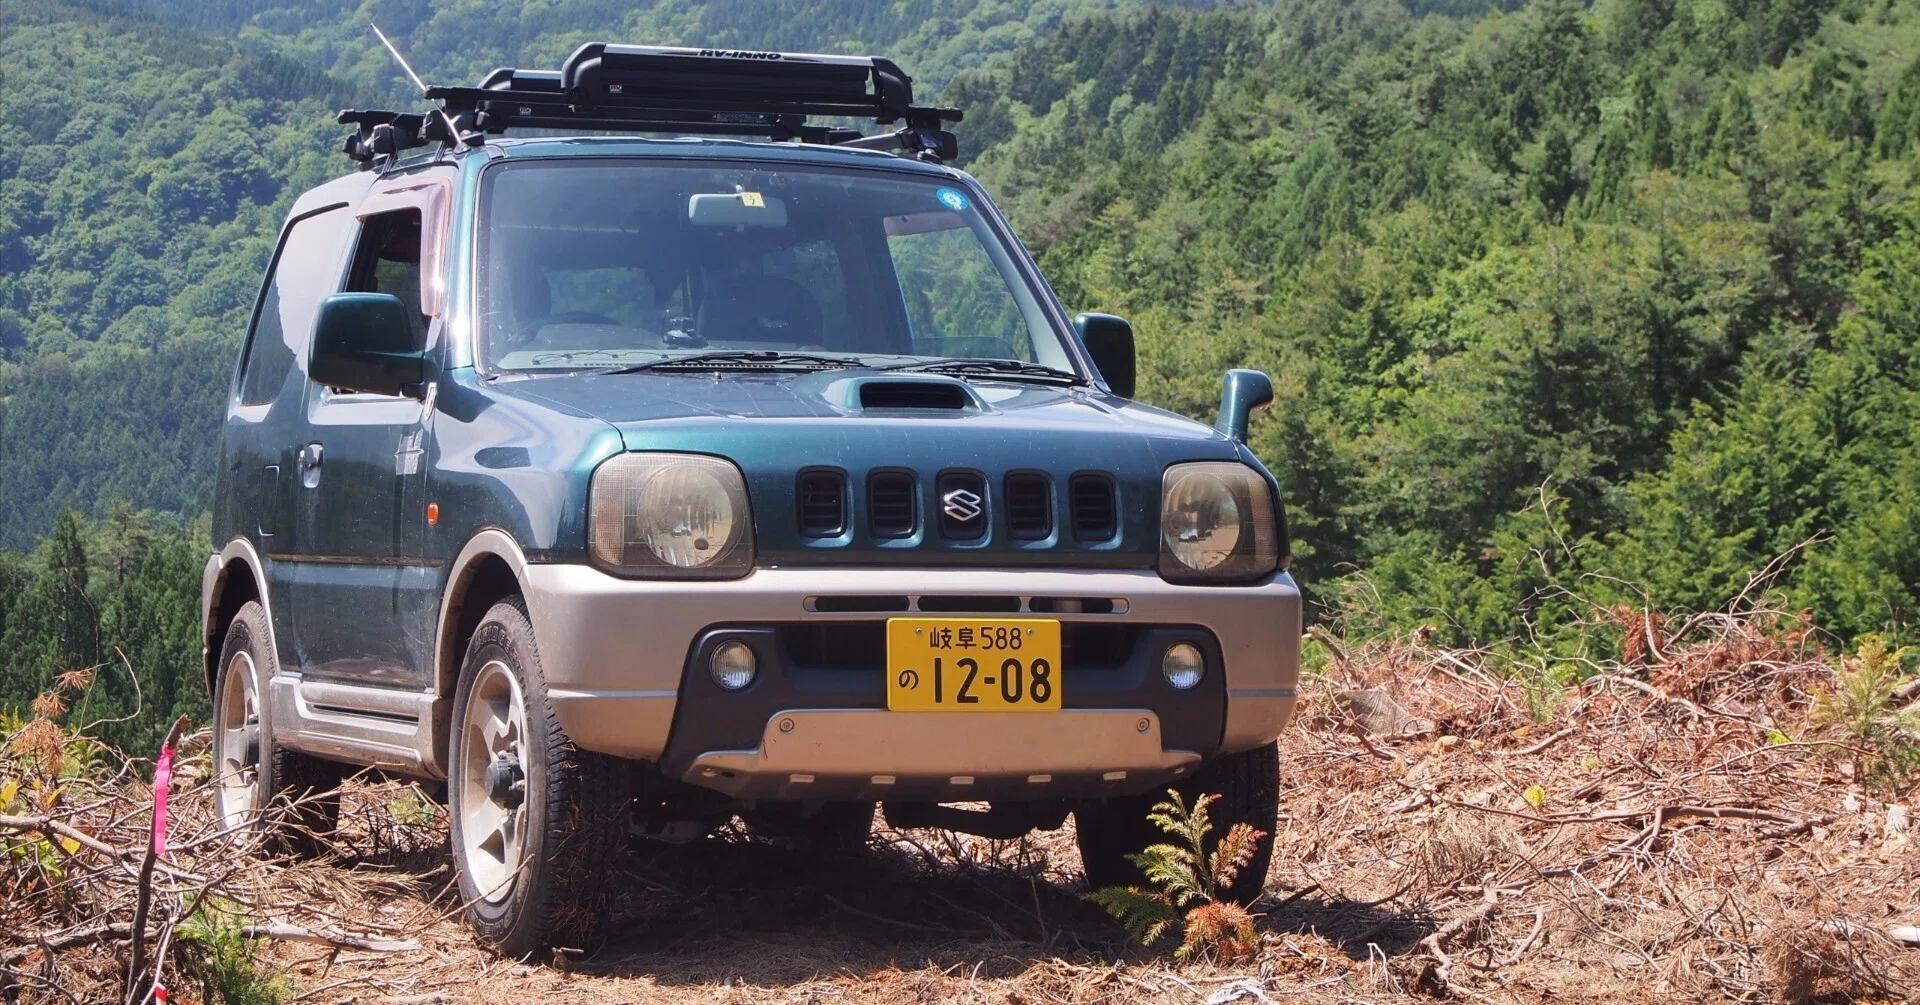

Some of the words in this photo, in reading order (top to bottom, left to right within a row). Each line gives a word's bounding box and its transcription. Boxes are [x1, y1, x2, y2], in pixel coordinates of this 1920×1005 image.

[699, 49, 782, 60] RV-INNO
[898, 669, 920, 691] の
[934, 657, 1052, 704] 12-08
